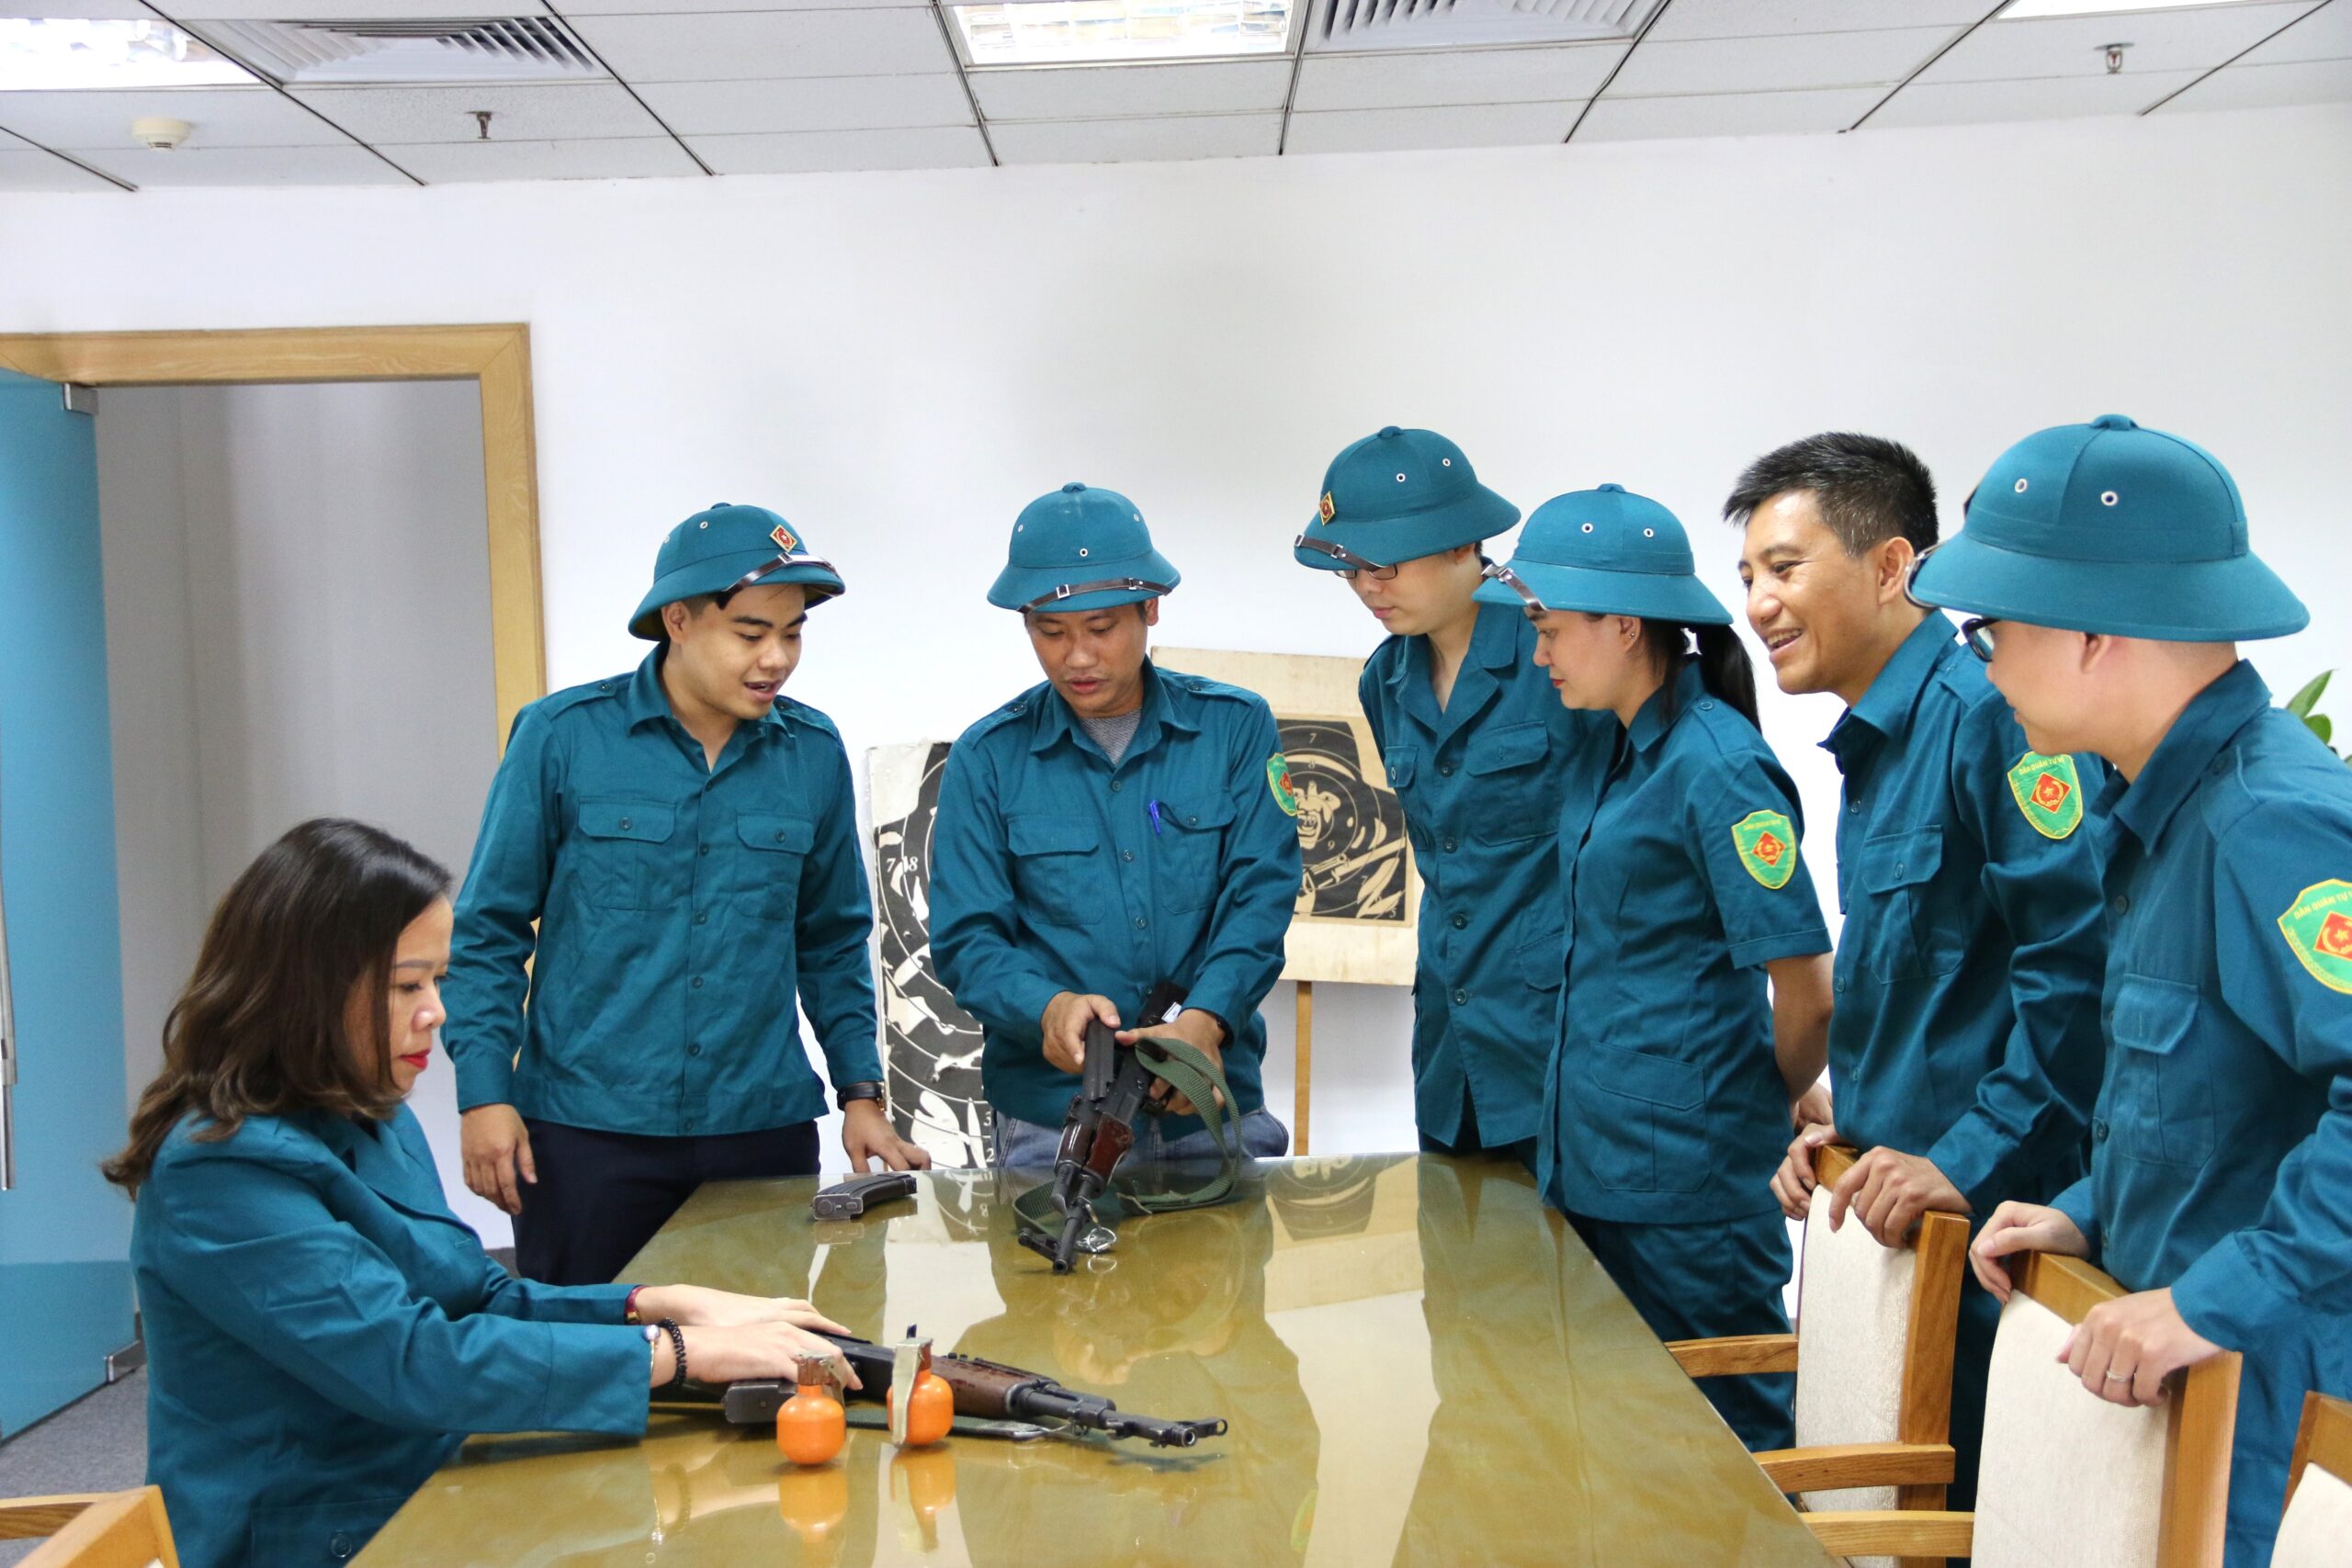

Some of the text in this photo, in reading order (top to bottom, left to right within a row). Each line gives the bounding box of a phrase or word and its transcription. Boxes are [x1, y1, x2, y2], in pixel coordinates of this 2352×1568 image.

[1308, 733, 1317, 743] 7
[1328, 840, 1336, 851] 9
[887, 858, 896, 872] 7
[909, 857, 919, 871] 8
[983, 1111, 992, 1126] 3
[985, 1147, 995, 1163] 2
